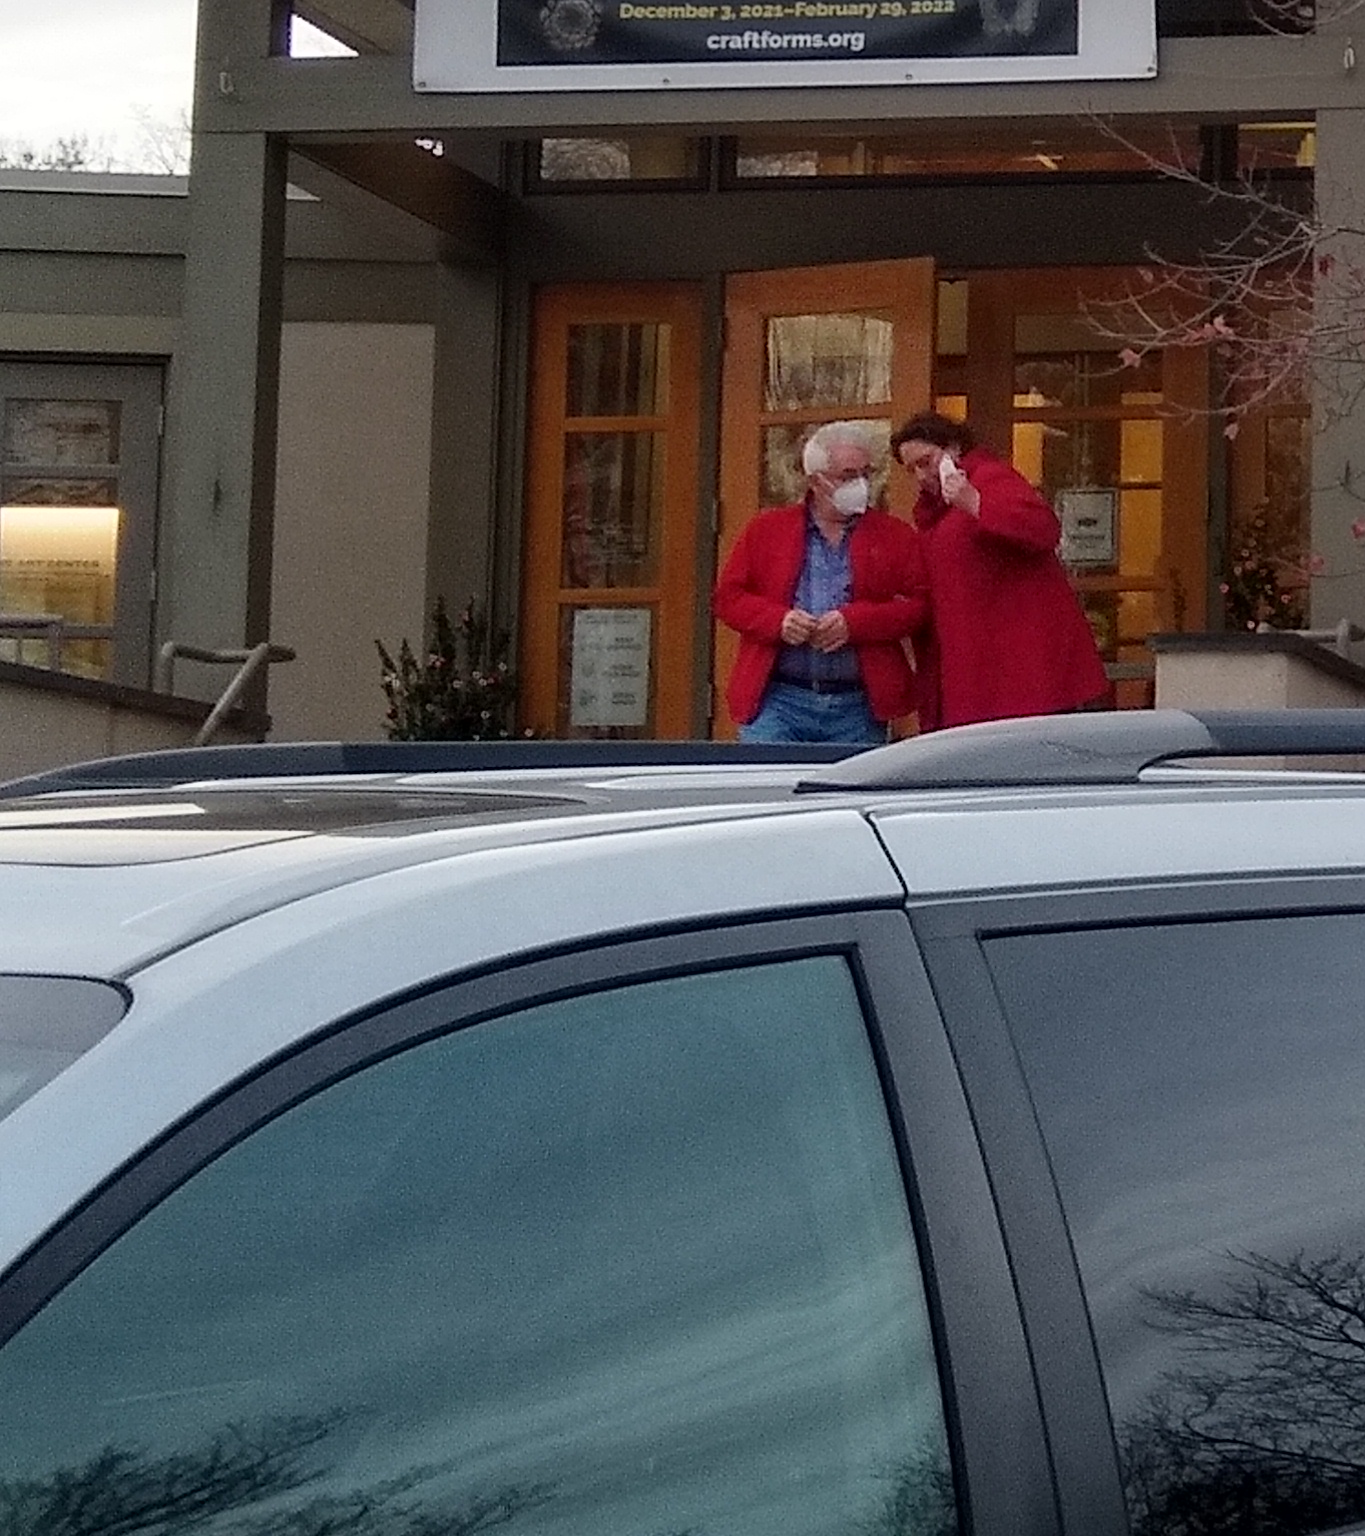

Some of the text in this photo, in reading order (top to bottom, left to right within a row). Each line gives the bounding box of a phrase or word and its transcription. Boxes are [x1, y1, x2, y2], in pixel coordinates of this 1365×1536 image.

[619, 3, 718, 19] December
[911, 0, 956, 14] 2022
[706, 30, 866, 51] craftforms.org
